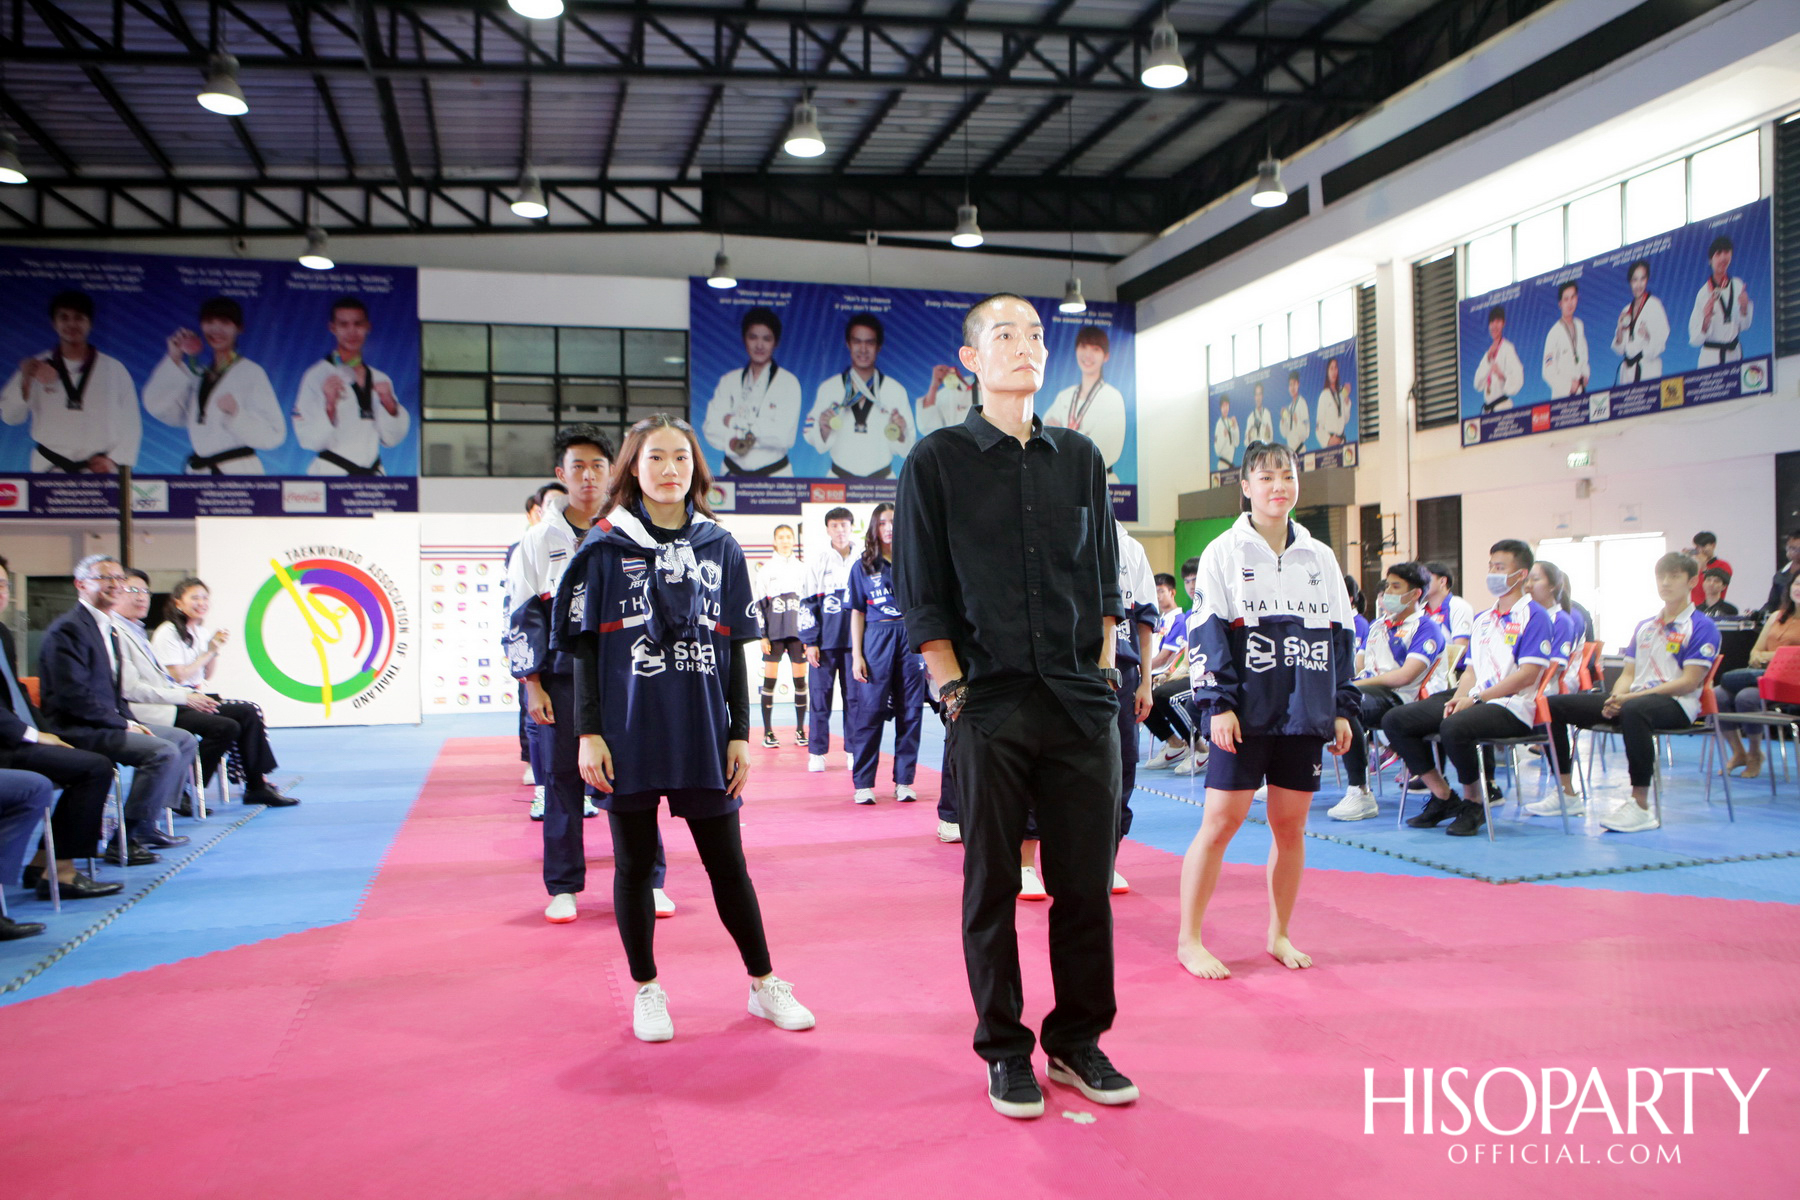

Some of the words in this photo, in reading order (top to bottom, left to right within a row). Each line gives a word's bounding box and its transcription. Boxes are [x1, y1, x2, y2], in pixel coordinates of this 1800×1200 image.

[285, 546, 363, 565] TAEKWONDO
[367, 563, 410, 634] ASSOCIATION
[1242, 600, 1329, 614] THAILAND
[394, 642, 409, 658] OF
[352, 663, 400, 710] THAILAND
